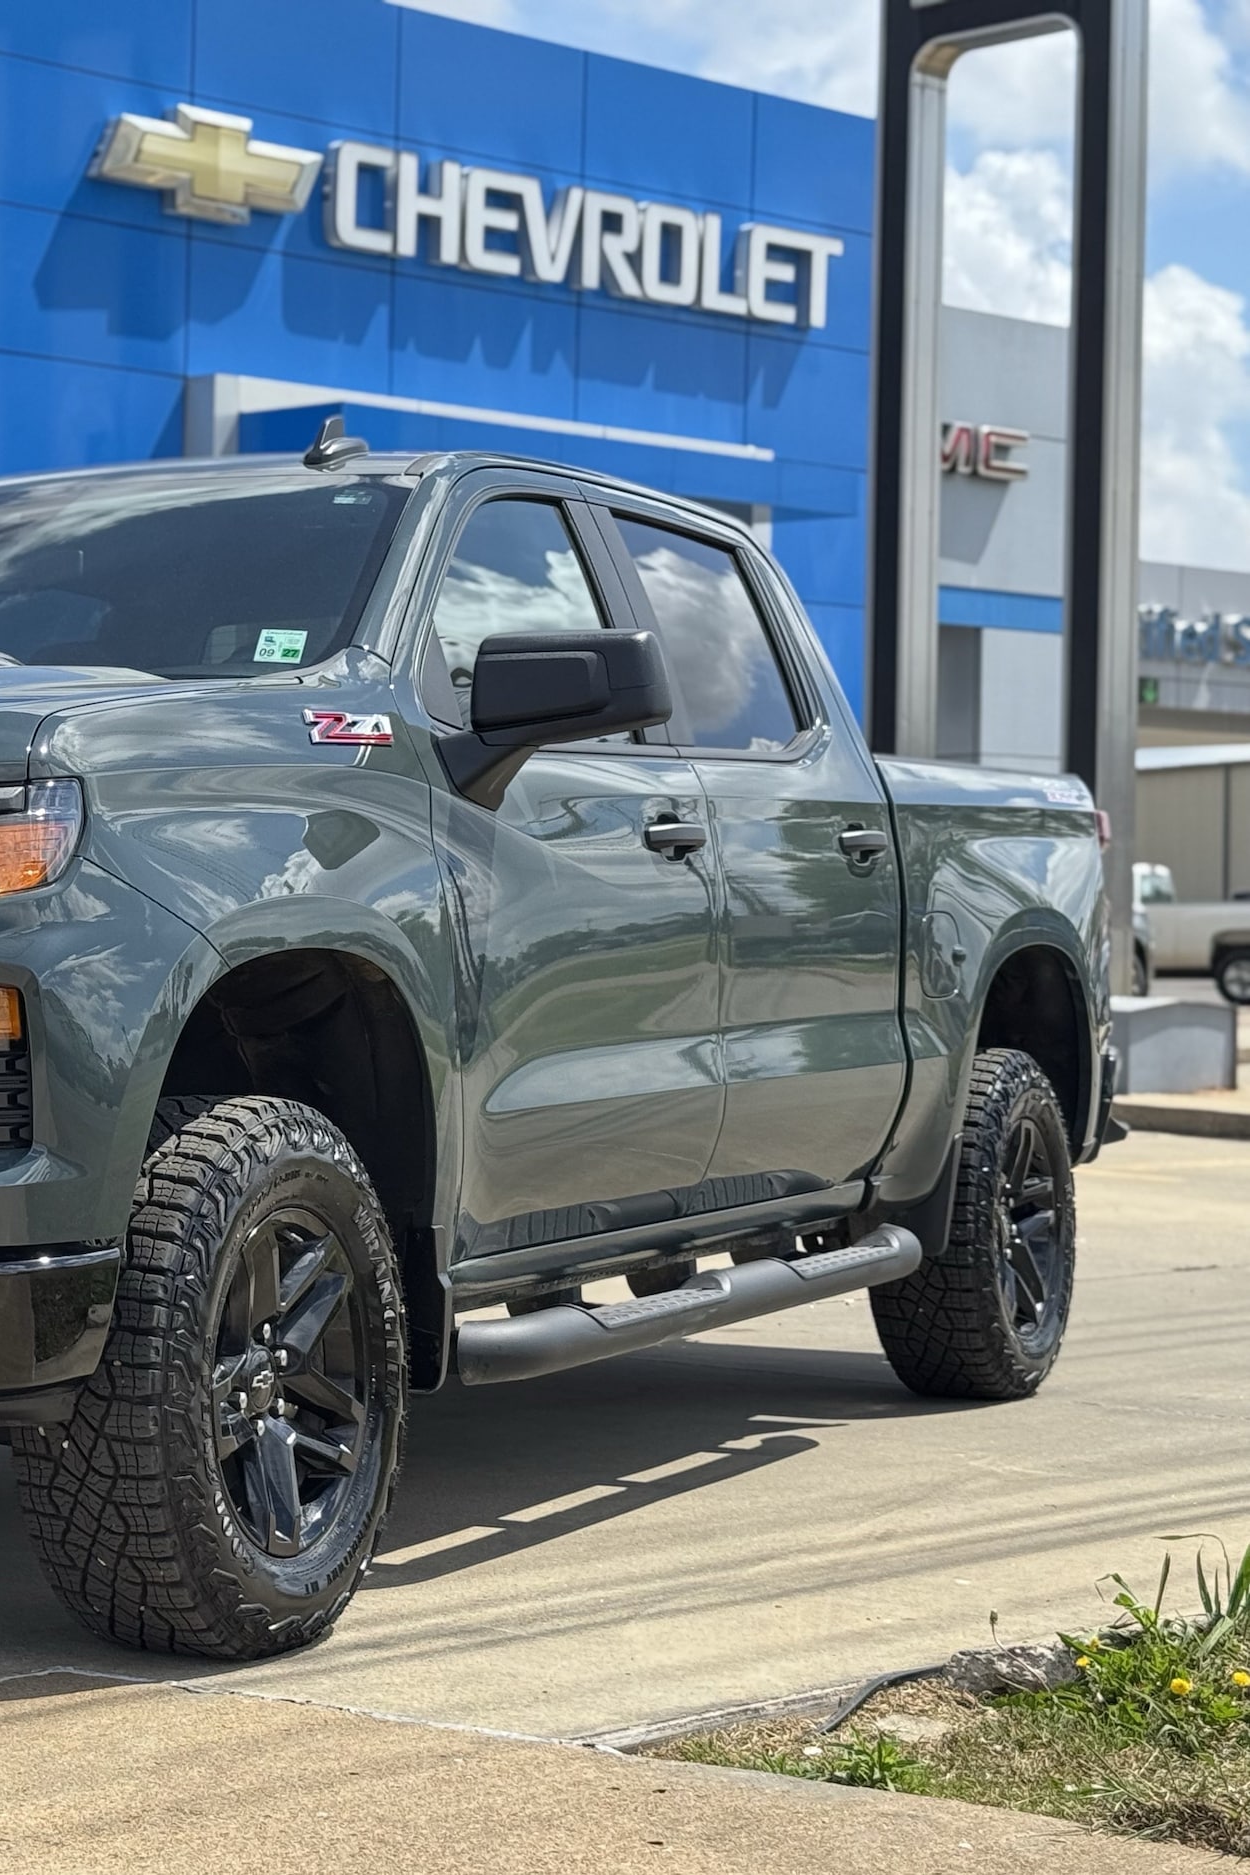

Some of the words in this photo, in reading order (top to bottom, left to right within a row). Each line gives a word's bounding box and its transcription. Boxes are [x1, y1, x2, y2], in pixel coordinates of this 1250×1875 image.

[325, 140, 844, 330] CHEVROLET
[940, 420, 1031, 482] MC
[259, 648, 275, 657] 09
[282, 648, 299, 658] 27
